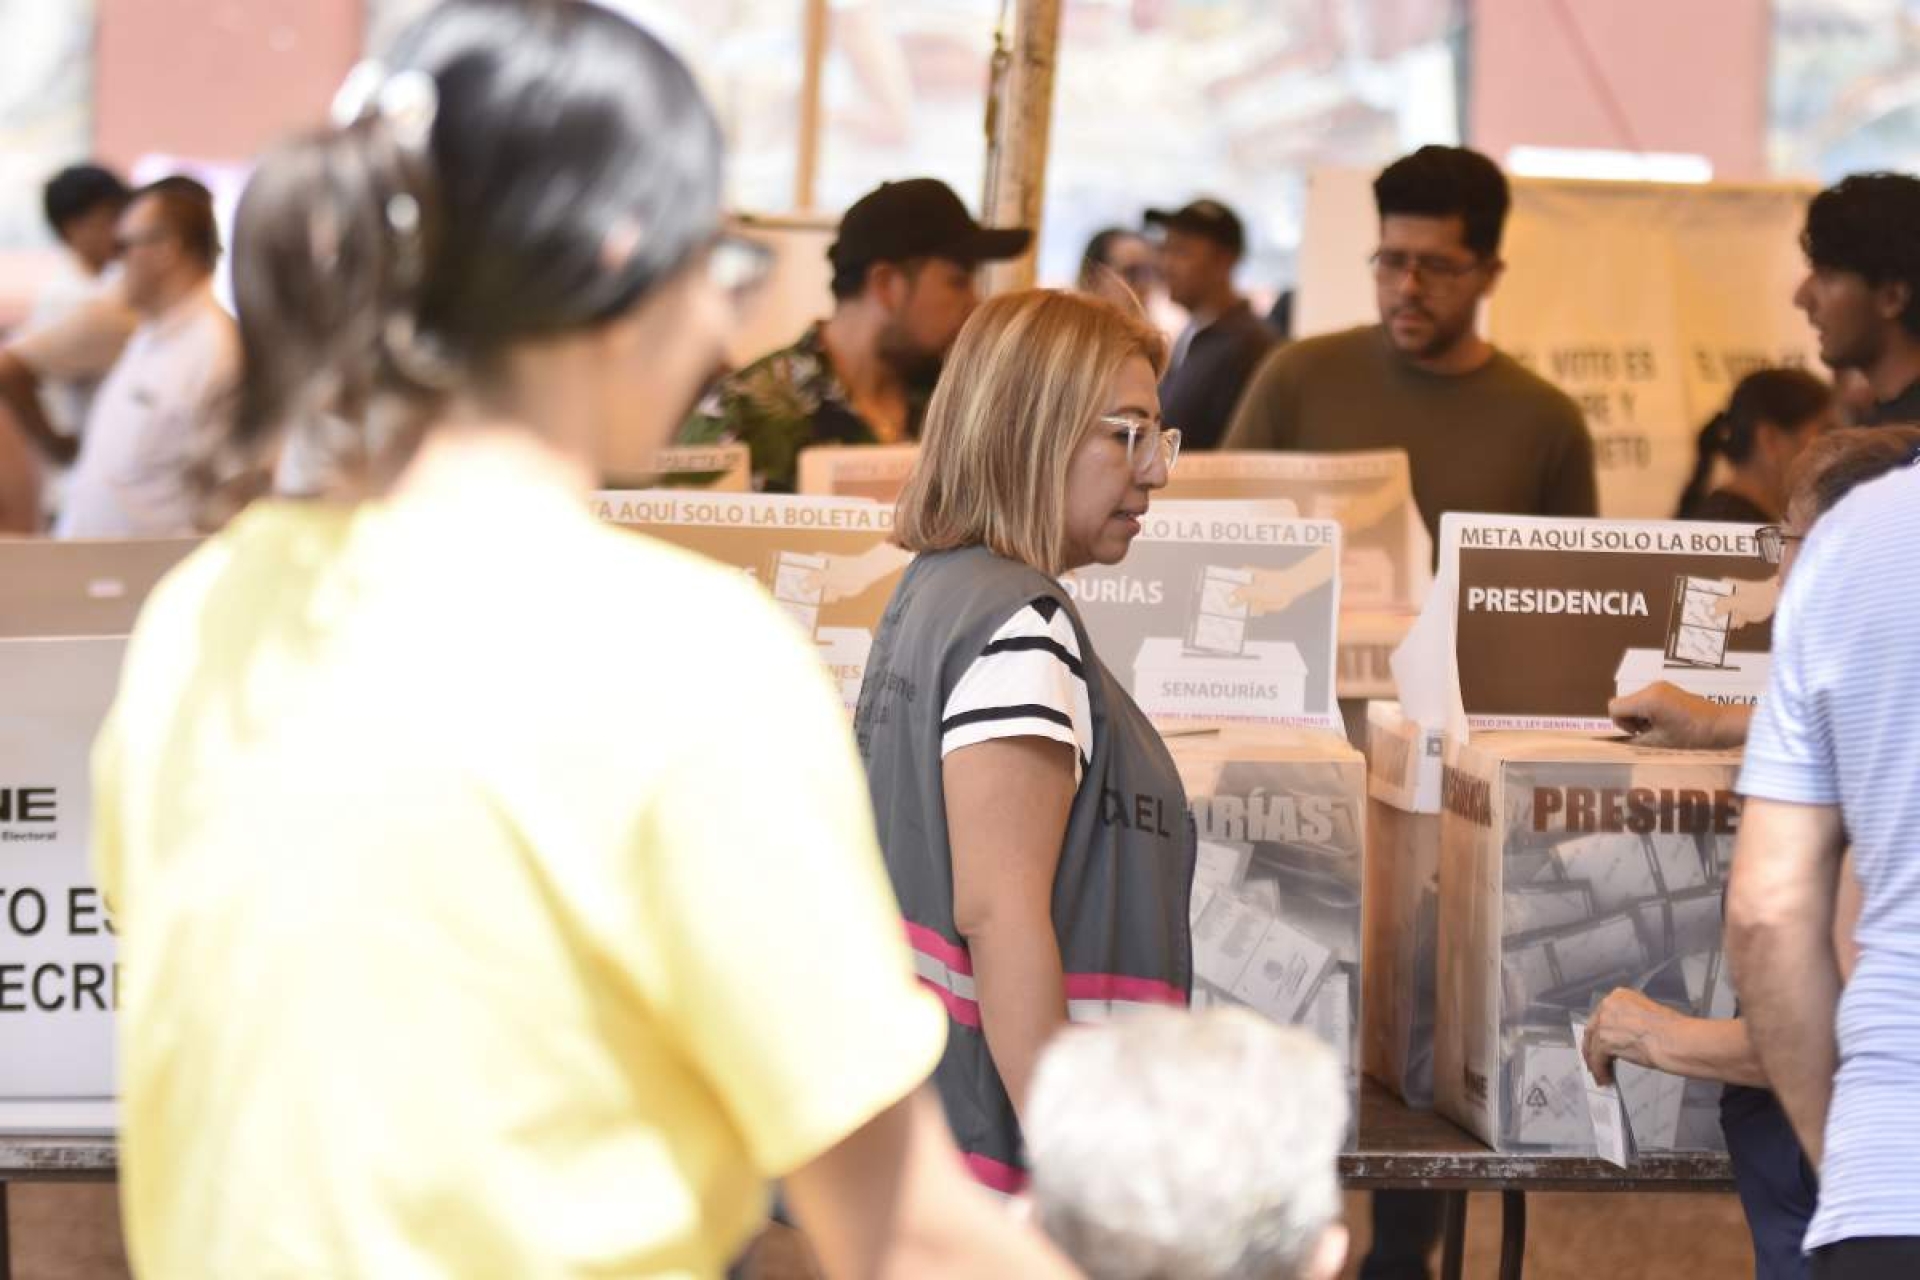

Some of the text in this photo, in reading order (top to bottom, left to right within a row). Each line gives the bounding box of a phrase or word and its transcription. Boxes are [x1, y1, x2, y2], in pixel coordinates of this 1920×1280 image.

[620, 500, 676, 522] AQUÍ
[683, 504, 743, 524] SOLO
[751, 505, 779, 525] LA
[785, 506, 870, 528] BOLETA
[1177, 522, 1201, 539] LA
[1211, 522, 1297, 542] BOLETA
[1305, 525, 1333, 543] DE
[1461, 527, 1522, 547] META
[1530, 528, 1586, 550] AQUÍ
[1592, 531, 1650, 550] SOLO
[1658, 533, 1684, 551] LA
[1467, 586, 1649, 617] PRESIDENCIA
[1160, 681, 1279, 701] SENADURÍAS
